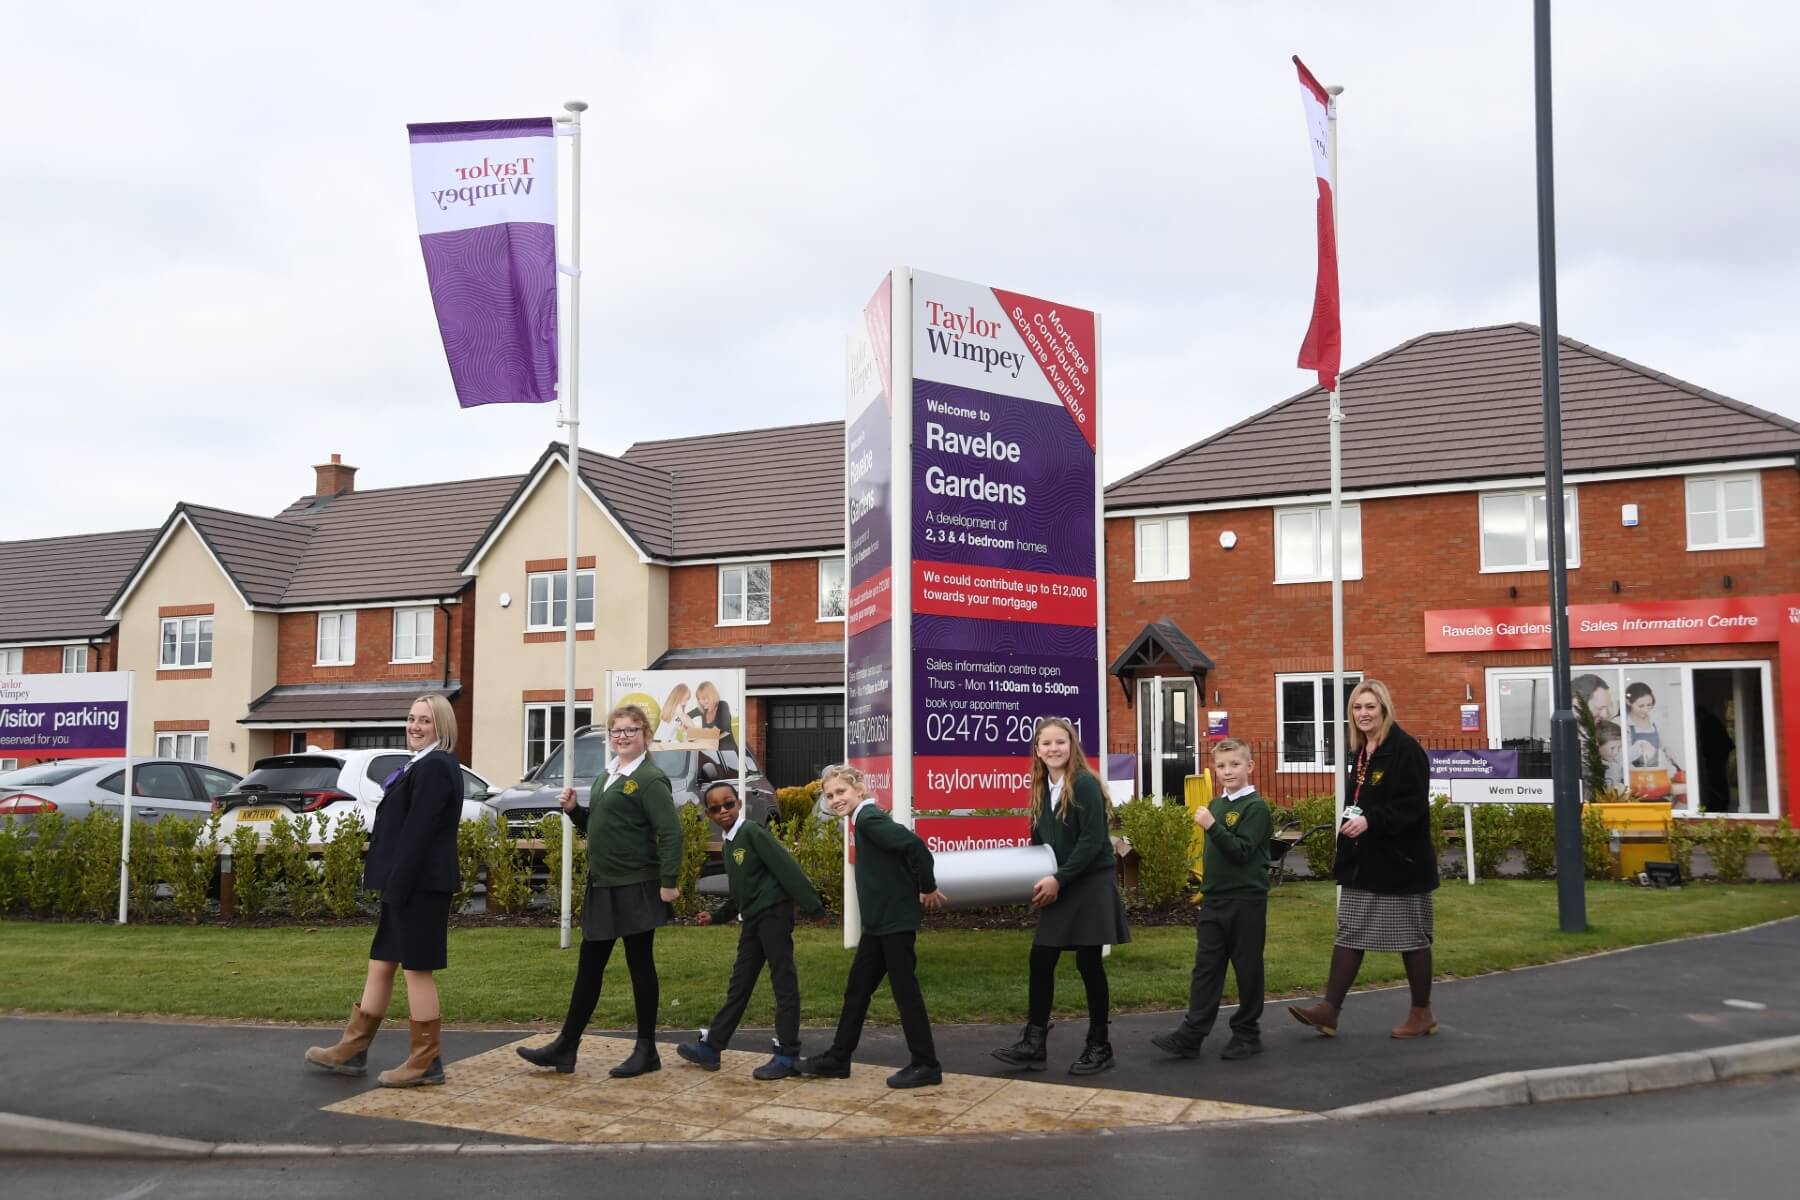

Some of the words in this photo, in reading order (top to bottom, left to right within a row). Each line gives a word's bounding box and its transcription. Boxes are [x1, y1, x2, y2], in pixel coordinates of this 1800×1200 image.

[926, 301, 1001, 340] Taylor
[926, 328, 1025, 378] Wimpey
[1048, 310, 1089, 375] Mortgage
[1012, 307, 1048, 363] Scheme
[1047, 364, 1086, 424] Available
[1033, 313, 1086, 396] Contribution
[926, 399, 977, 420] Welcome
[980, 410, 991, 422] to
[926, 421, 1021, 463] Raveloe
[925, 466, 1026, 506] Gardens
[925, 510, 934, 523] A
[936, 512, 996, 530] development
[998, 519, 1008, 531] of
[925, 528, 936, 544] 2,
[938, 530, 946, 542] 3
[948, 531, 956, 543] &
[958, 532, 966, 545] 4
[968, 533, 1014, 550] bedroom
[1016, 539, 1048, 554] homes
[923, 570, 940, 583] We
[943, 574, 971, 587] could
[974, 577, 1024, 592] contribute
[1025, 583, 1038, 595] up
[1040, 582, 1050, 595] to
[1052, 583, 1088, 599] £12,000
[923, 588, 966, 603] towards
[967, 594, 990, 606] your
[992, 595, 1038, 611] mortgage
[1442, 624, 1494, 638] Raveloe
[1496, 623, 1552, 636] Gardens
[1579, 618, 1618, 633] Sales
[1622, 616, 1704, 631] Information
[1707, 615, 1759, 628] Centre
[926, 658, 953, 672] Sales
[955, 660, 1007, 674] information
[1008, 663, 1037, 676] centre
[1039, 666, 1061, 678] open
[0, 679, 22, 691] aylor
[927, 676, 955, 690] Thurs
[965, 678, 986, 691] Mon
[988, 679, 1030, 693] 11:00am
[1032, 682, 1043, 693] to
[1044, 683, 1079, 697] 5:00pm
[926, 698, 948, 709] book
[950, 700, 967, 710] your
[969, 700, 1019, 712] appointment
[53, 706, 120, 731] parking
[926, 713, 999, 742] 02475
[1005, 715, 1082, 743] 2601
[0, 733, 35, 745] eserved
[38, 733, 50, 744] for
[52, 734, 70, 747] you
[1436, 766, 1448, 774] get
[1463, 765, 1493, 774] moving?
[1472, 758, 1488, 767] help
[927, 768, 1032, 794] taylorwimpe
[1489, 786, 1514, 795] Wem
[1517, 785, 1543, 795] Drive
[927, 836, 1014, 853] Showhomes
